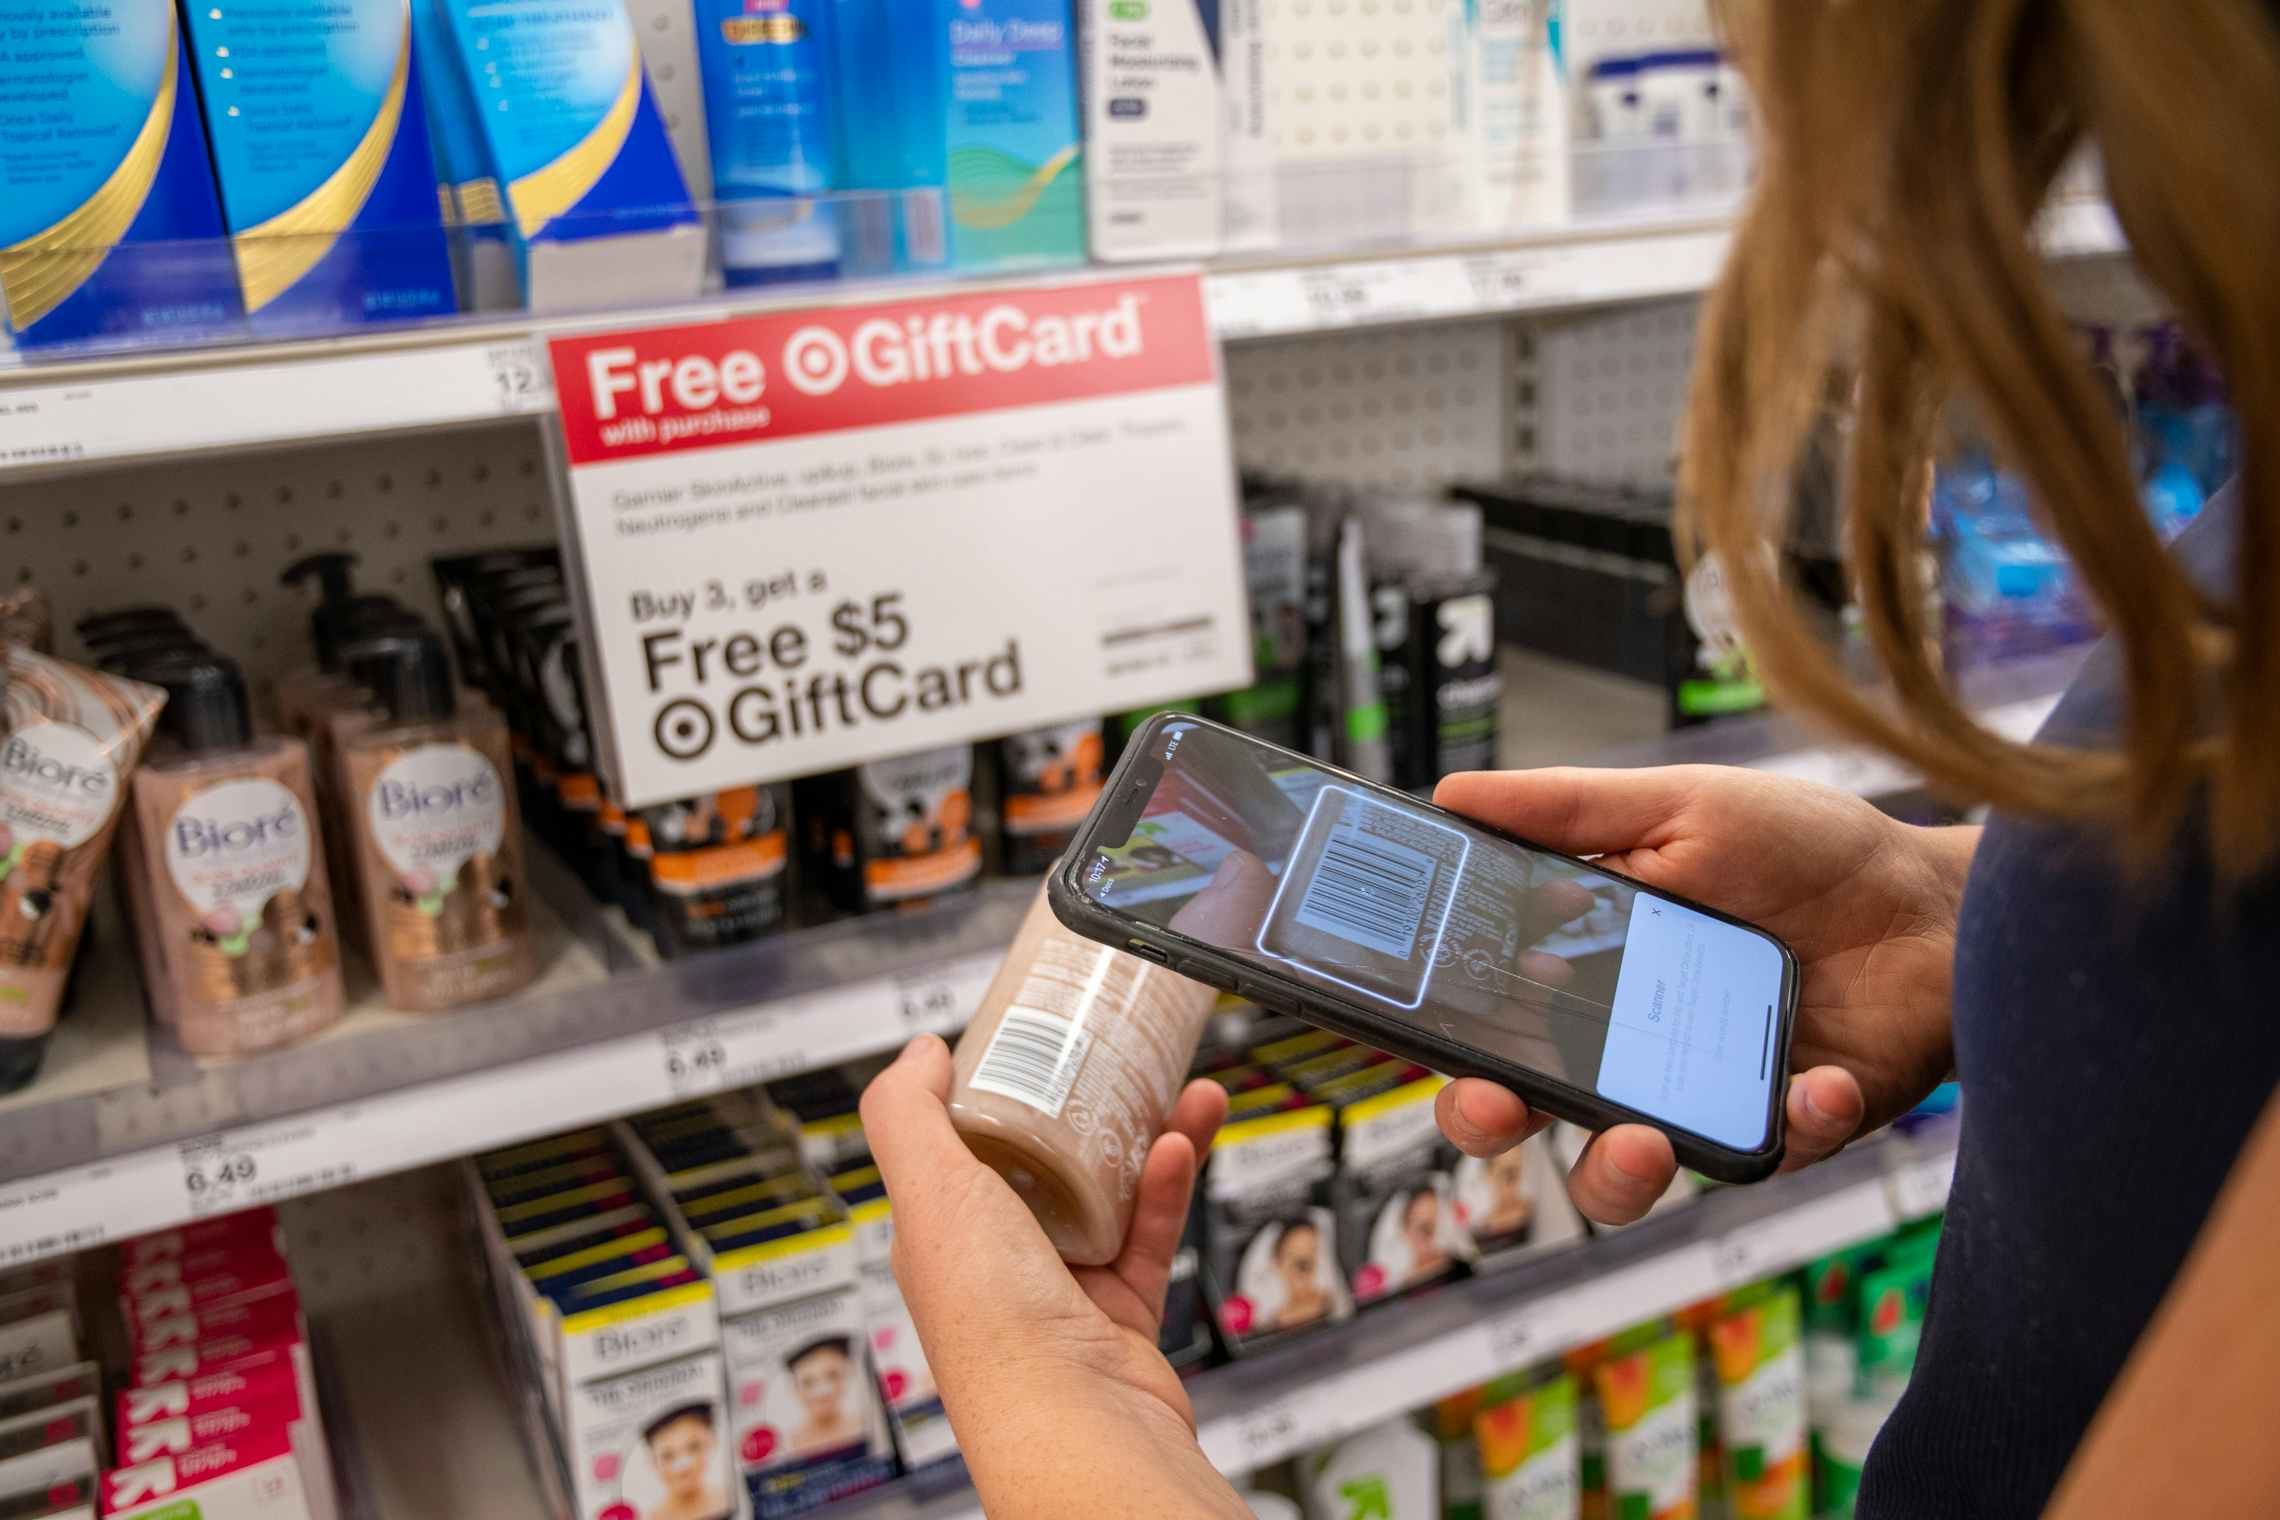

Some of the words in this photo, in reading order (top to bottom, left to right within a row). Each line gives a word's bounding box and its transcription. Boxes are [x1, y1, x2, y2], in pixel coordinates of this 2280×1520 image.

[586, 346, 766, 420] Free
[853, 293, 1144, 387] GiftCard
[600, 416, 656, 447] with
[659, 404, 771, 445] purchase
[630, 589, 695, 622] Buy
[705, 578, 736, 611] 3,
[746, 570, 798, 607] get
[807, 571, 829, 594] a
[640, 624, 807, 693] Free
[830, 592, 909, 659] $5
[728, 637, 1024, 745] GiftCard
[4, 736, 109, 793] Bioré
[381, 766, 492, 818] Bioré
[175, 796, 297, 857] Bioré
[1648, 979, 1669, 1022] Scanner
[184, 1154, 257, 1193] 6.49
